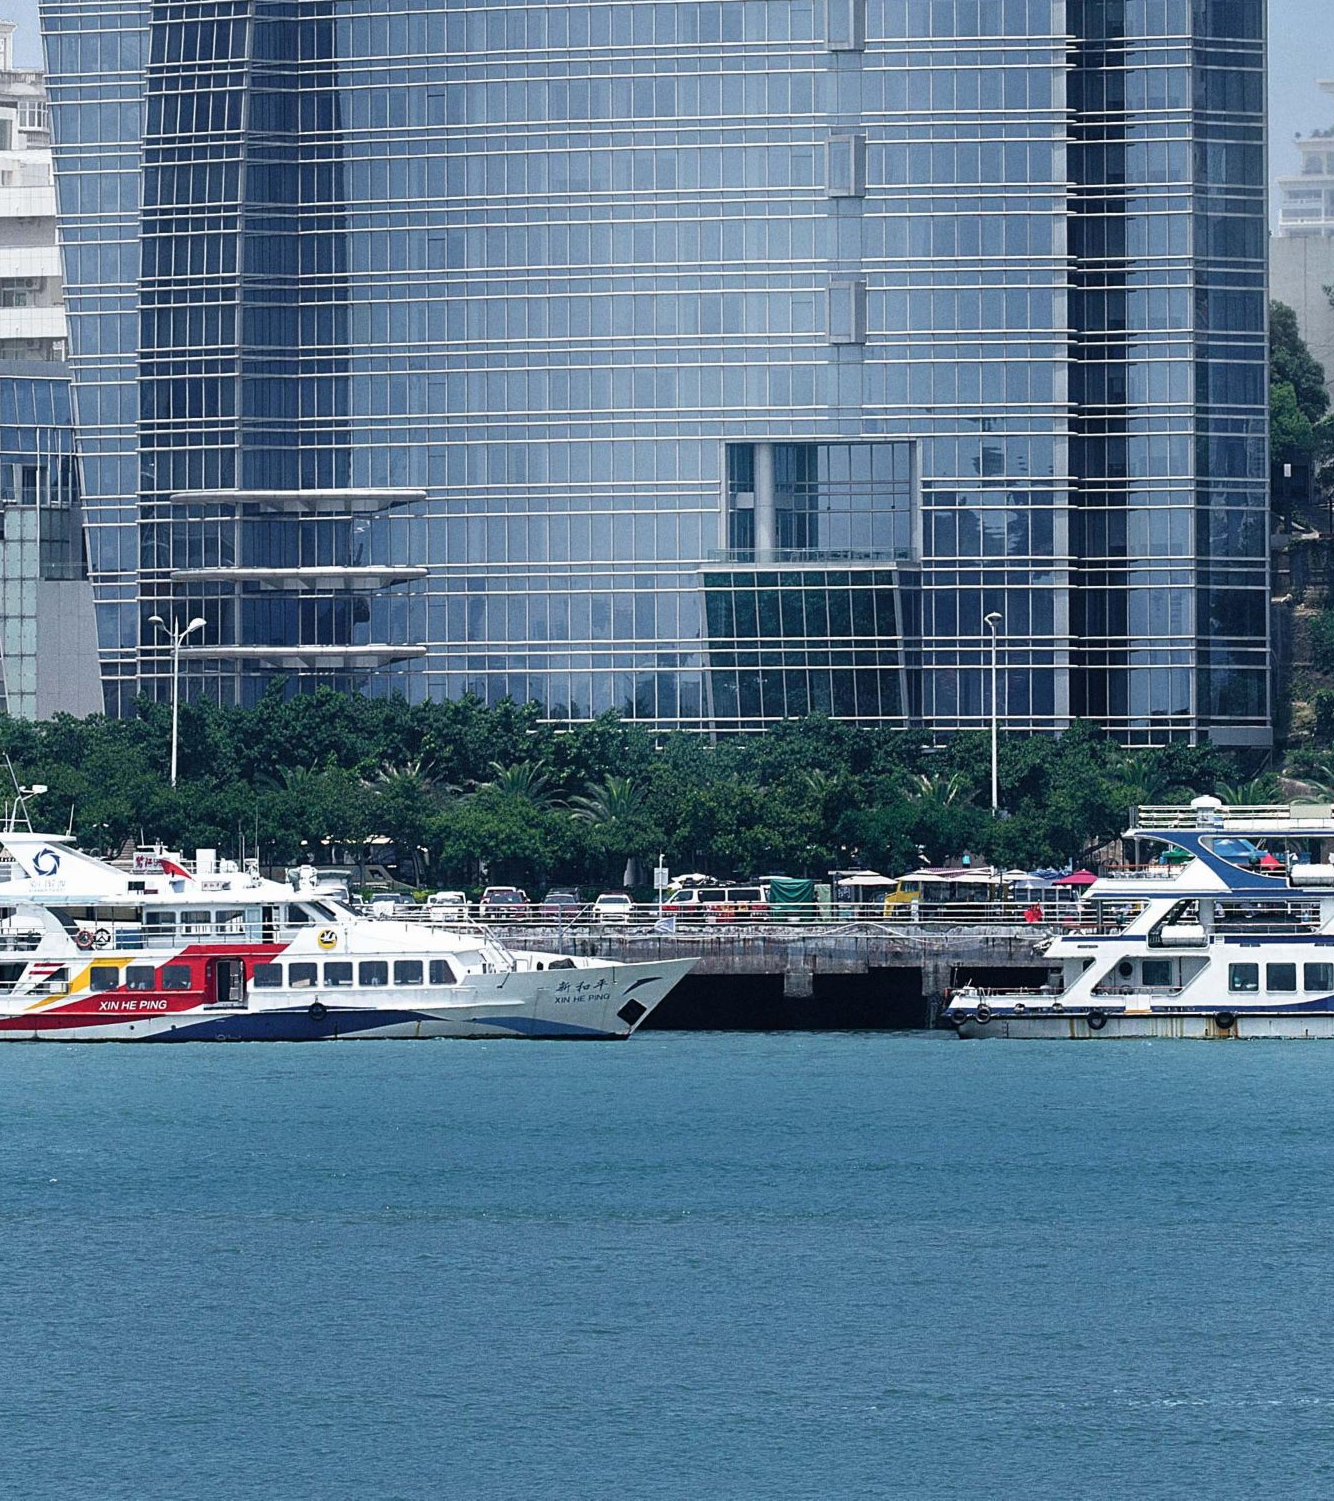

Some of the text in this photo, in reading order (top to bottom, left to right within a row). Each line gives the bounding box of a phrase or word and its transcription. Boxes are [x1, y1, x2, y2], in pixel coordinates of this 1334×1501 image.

[554, 993, 610, 1004] XIN HE PING
[99, 999, 167, 1011] XIN HE PING
